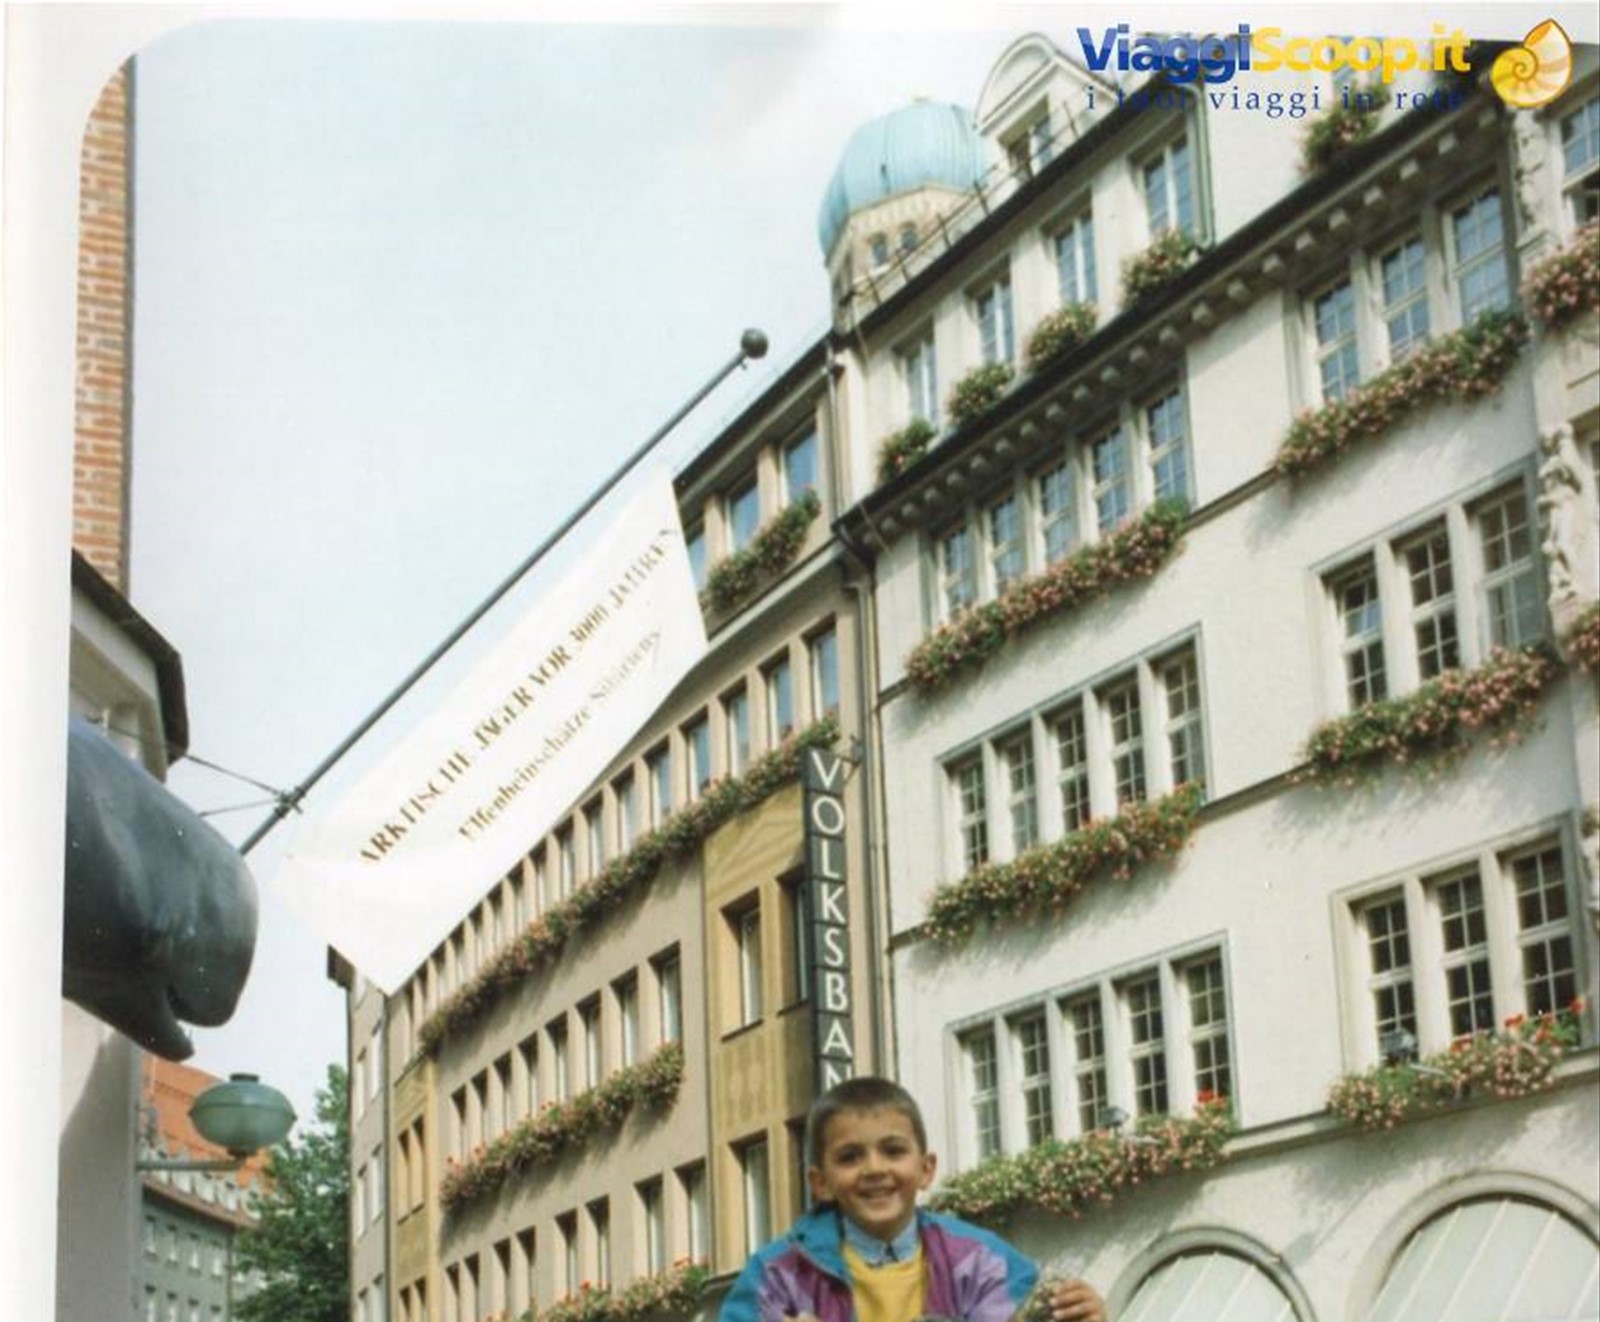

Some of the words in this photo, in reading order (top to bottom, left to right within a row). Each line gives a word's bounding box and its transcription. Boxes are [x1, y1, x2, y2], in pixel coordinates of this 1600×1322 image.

[361, 751, 471, 862] ARKTISCHE
[528, 645, 573, 687] VOR
[810, 750, 854, 1090] VOLKSBAN
